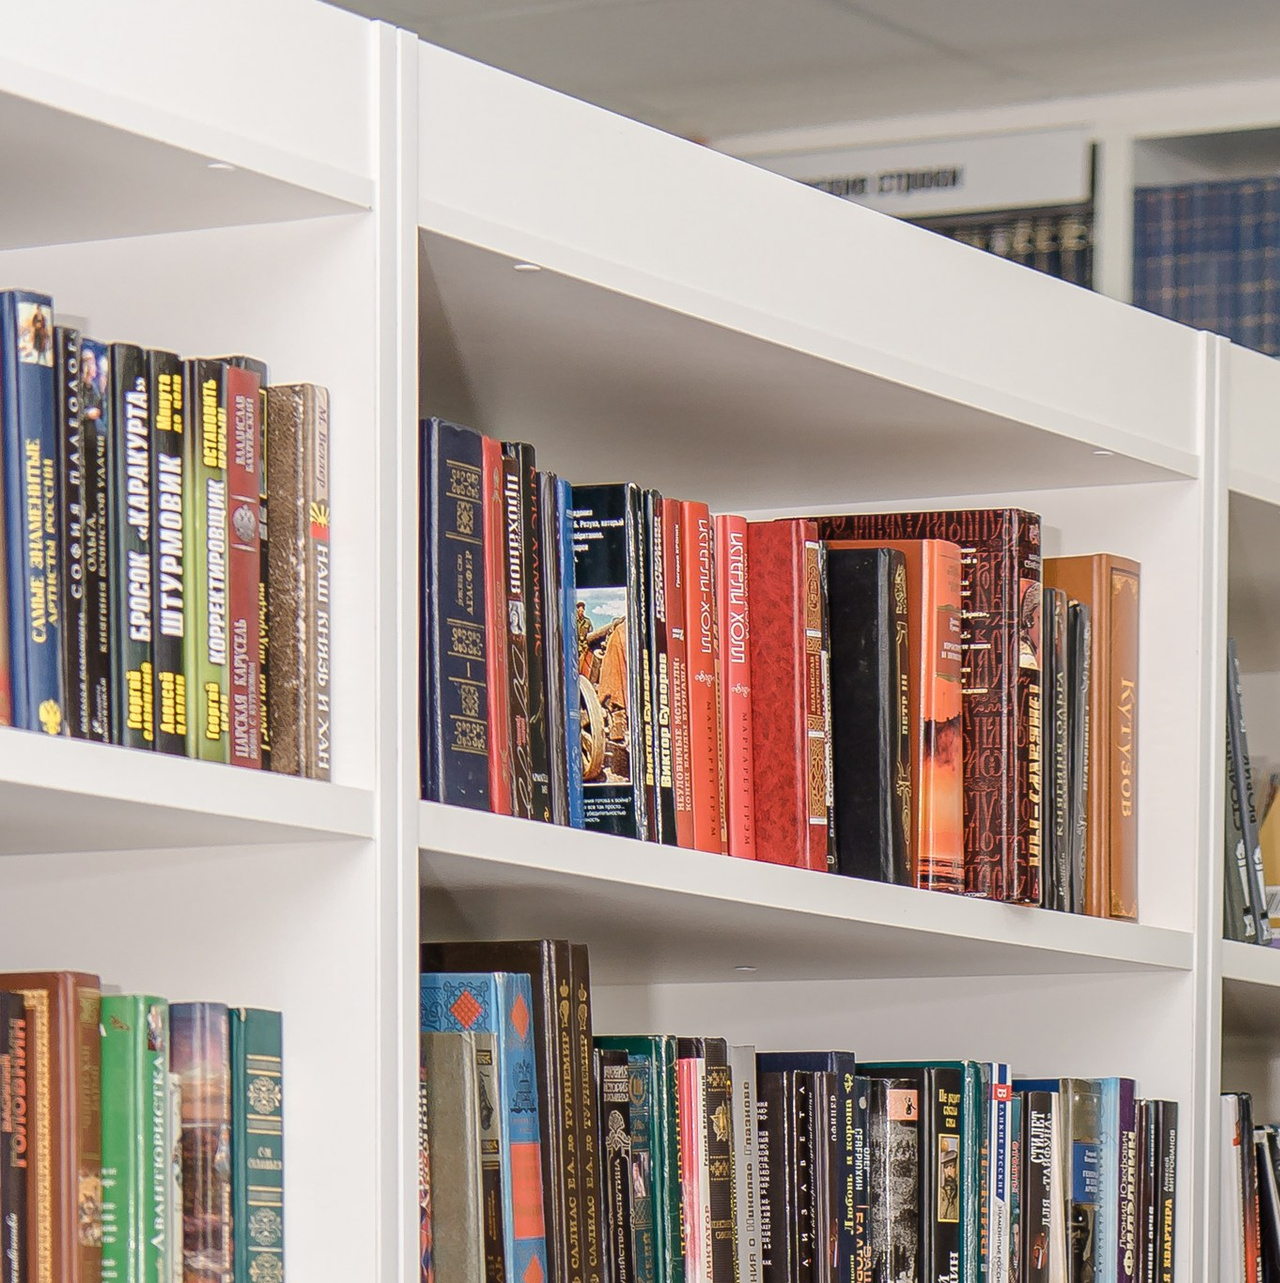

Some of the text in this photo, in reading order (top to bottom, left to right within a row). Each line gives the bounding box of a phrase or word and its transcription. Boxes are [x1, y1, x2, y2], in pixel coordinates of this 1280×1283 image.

[154, 373, 173, 431] Минута
[201, 378, 218, 468] ОСТАНОВИТЬ
[314, 434, 326, 489] Веллер
[23, 438, 47, 643] САМЫЕ ЗНАМЕНИТЫЕ
[42, 458, 59, 628] АРТИСТЫ РОССИИ
[123, 376, 152, 642] БРОСОК «КАРАКУРТА»
[156, 453, 184, 638] ШТУРМОВИК
[505, 473, 524, 594] Проханов
[69, 502, 83, 599] СОФИЯ
[205, 478, 227, 664] КОРРЕКТИРОВЩИК
[697, 518, 713, 654] ИСТЕРЛИ-ХОЛЛ
[729, 532, 746, 605] ИСТЕРЛИ
[310, 545, 326, 771] НАШ КНЯЗЬ И ХАН
[730, 611, 747, 664] ХОЛЛ
[124, 670, 142, 729] Георгий
[157, 671, 176, 735] Алексей
[203, 682, 221, 741] Георгий
[232, 618, 250, 758] ЦАРСКАЯ КАРУСЕЛЬ
[658, 652, 672, 788] Виктор Суворов
[901, 694, 910, 736] ПЕТР
[676, 724, 686, 811] НЕУЛОВИМЫЕ
[1054, 671, 1066, 837] КНЯГИНЯ ОЛЬГА
[1118, 678, 1135, 818] КУТУЗОВ
[8, 1018, 27, 1169] ГОЛОВНИН
[560, 1032, 574, 1129] ТУРНЕМИР
[578, 1035, 591, 1129] ТУРНЕМИР
[843, 1099, 854, 1151] корона
[1029, 1110, 1045, 1163] СТИЛЕТ
[1166, 1129, 1175, 1193] МИТРОФАНОВ
[566, 1155, 578, 1190] Е.А.
[613, 1158, 625, 1226] РАСПУТИНА
[842, 1171, 856, 1237] Любовь
[1118, 1130, 1130, 1250] Леонид Юзефович
[1161, 1157, 1169, 1193] Алексей
[567, 1196, 581, 1270] САЛИАС
[585, 1193, 598, 1267] САЛИАС
[702, 1204, 713, 1280] ДИКТАТОР
[1042, 1198, 1051, 1228] ДЛЯ
[1162, 1198, 1173, 1269] КВАРТИРА
